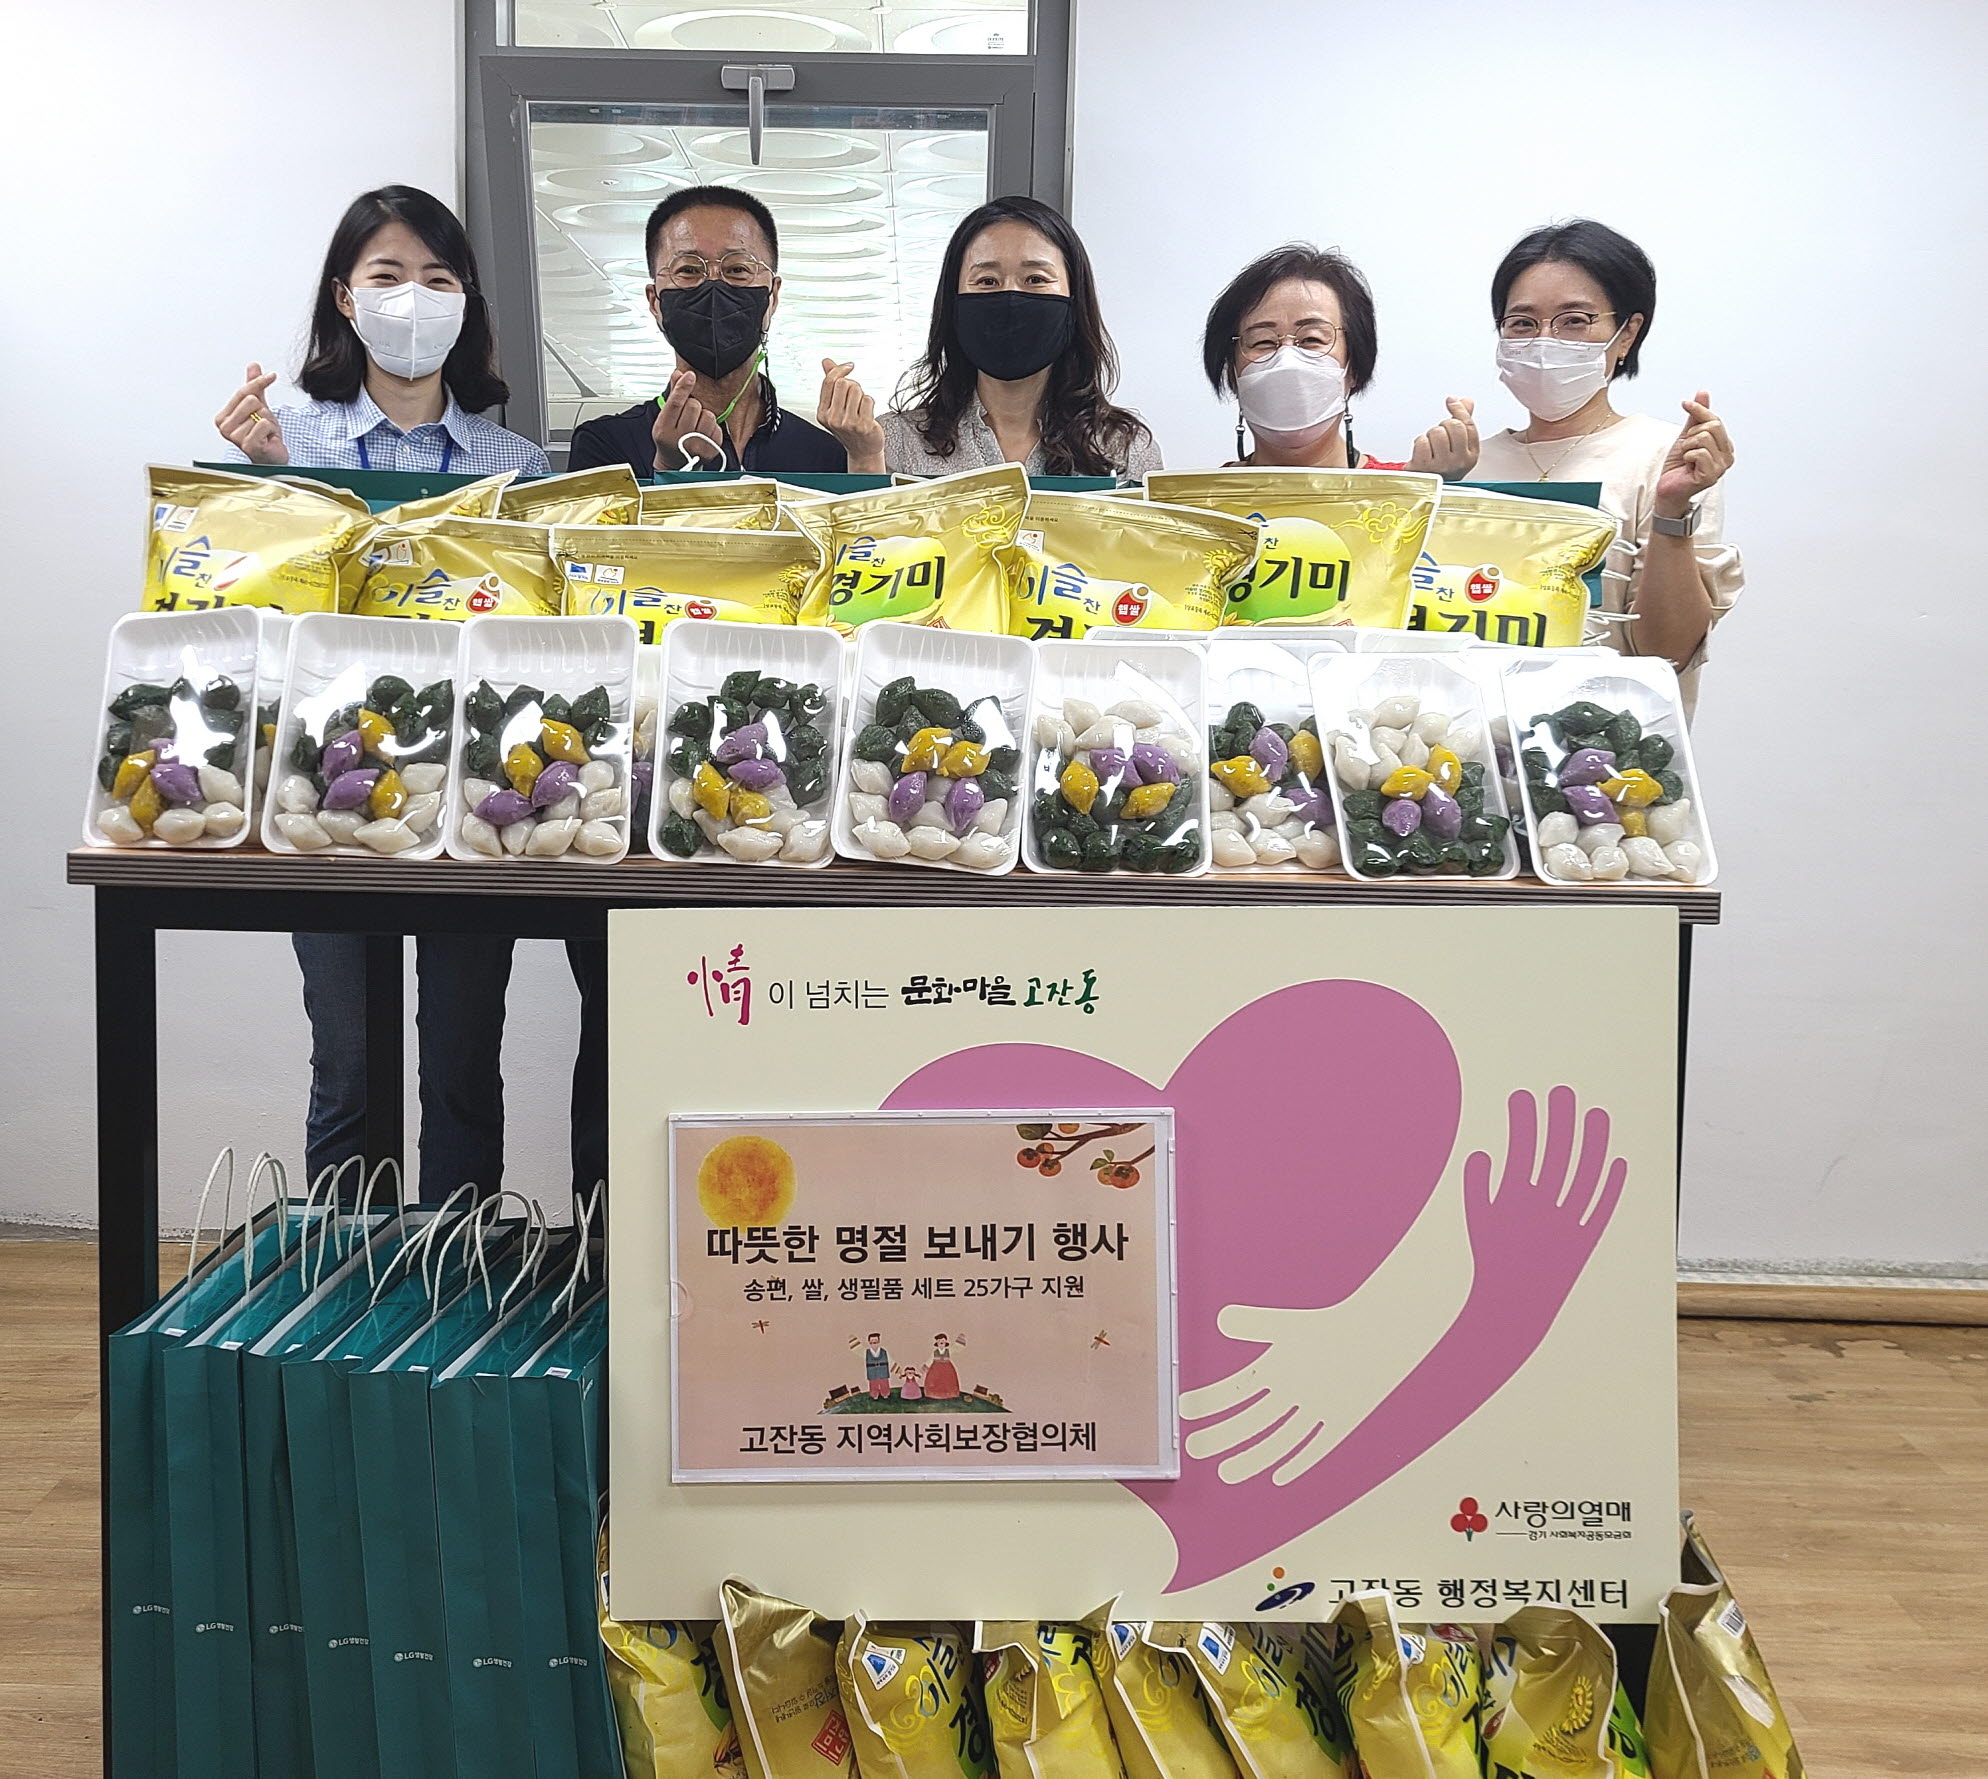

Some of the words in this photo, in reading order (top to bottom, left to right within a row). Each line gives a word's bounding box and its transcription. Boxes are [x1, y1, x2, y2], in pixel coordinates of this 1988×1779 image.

[829, 556, 946, 605] 경기미
[1411, 551, 1455, 602] 슬찬
[1117, 603, 1141, 616] 햅쌀
[688, 944, 750, 1025] 情
[806, 979, 890, 1010] 넘치는
[901, 975, 1017, 1006] 문화마을
[1023, 968, 1100, 1014] 고잔동
[707, 1225, 820, 1264] 따뜻한
[836, 1224, 908, 1263] 명절
[923, 1223, 1035, 1262] 보내기
[1052, 1222, 1129, 1262] 행사
[743, 1276, 793, 1302] 송편,
[801, 1278, 829, 1302] 쌀,
[837, 1277, 904, 1301] 생필품
[911, 1277, 956, 1300] 세트
[963, 1276, 1034, 1299] 25가구
[1041, 1275, 1085, 1299] 지원
[739, 1424, 827, 1455] 고잔동
[836, 1421, 1097, 1454] 지역사회보장협의체
[1494, 1500, 1632, 1529] 사랑의열매
[1528, 1530, 1547, 1542] 경기
[1549, 1530, 1632, 1542] 사회복지공동모금회
[1437, 1578, 1629, 1609] 행정복지센터
